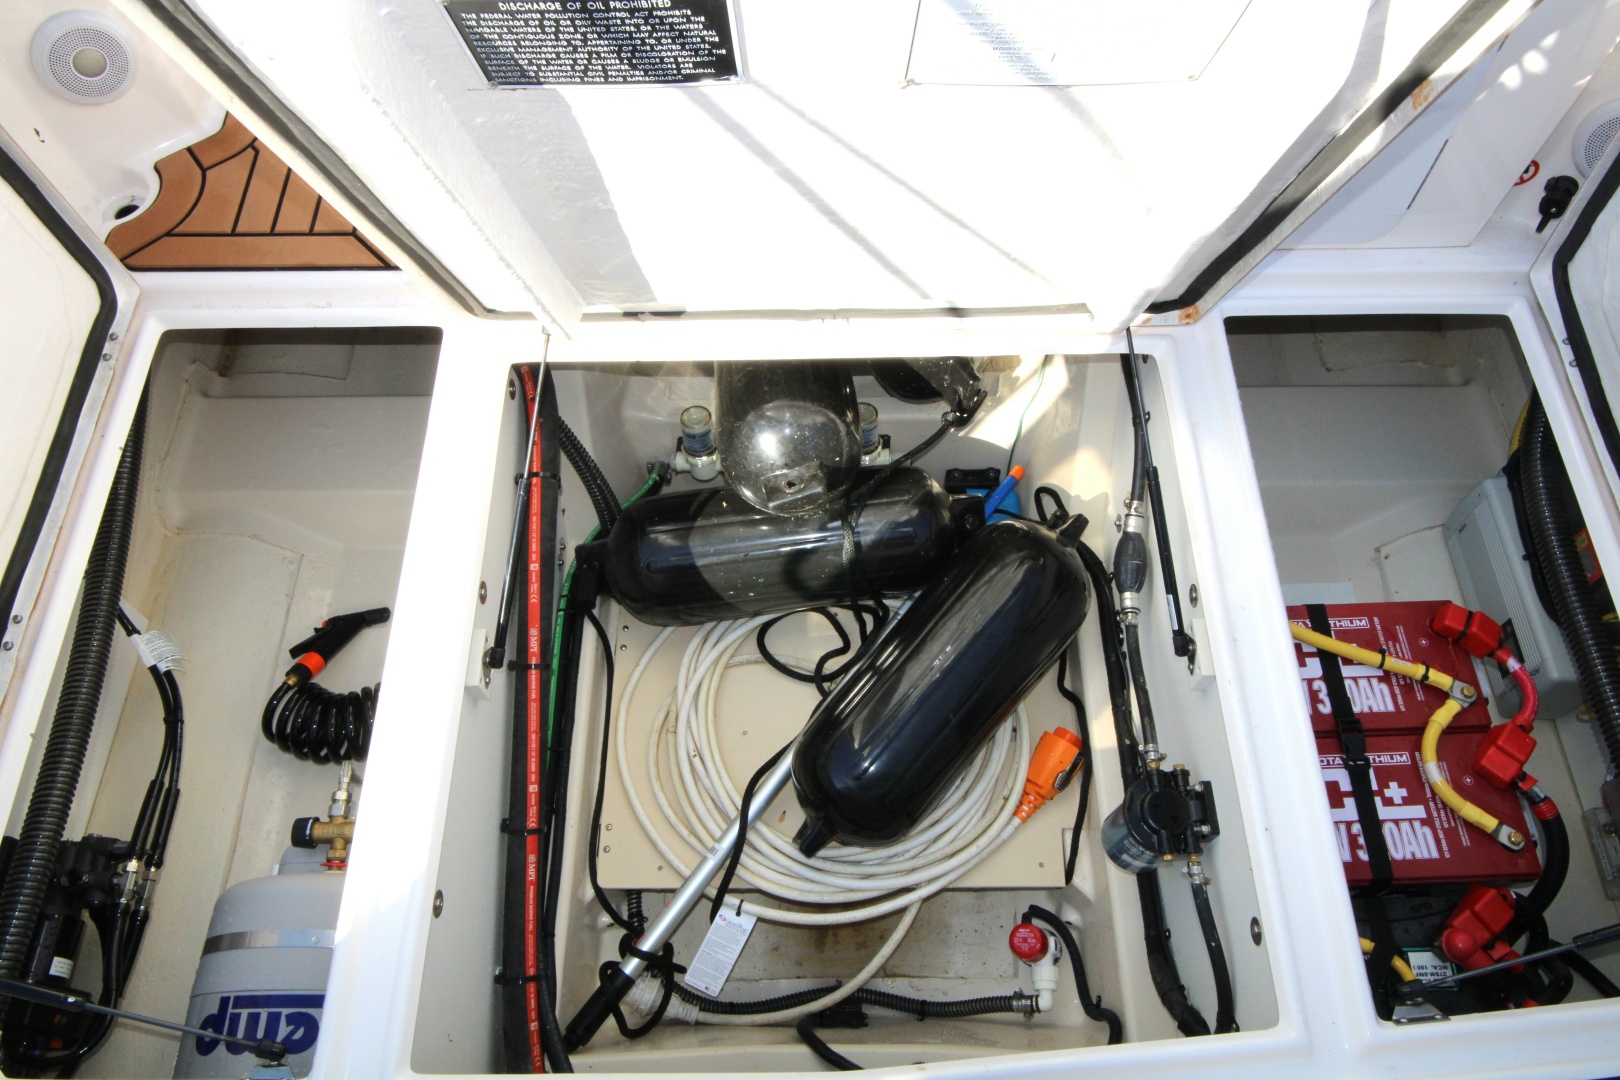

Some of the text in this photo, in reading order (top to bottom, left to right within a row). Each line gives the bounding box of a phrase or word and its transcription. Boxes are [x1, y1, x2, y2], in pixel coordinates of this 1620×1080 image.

[499, 0, 671, 10] DISCHARGE OF OIL PROHIBITED
[1429, 801, 1438, 816] BATTERY
